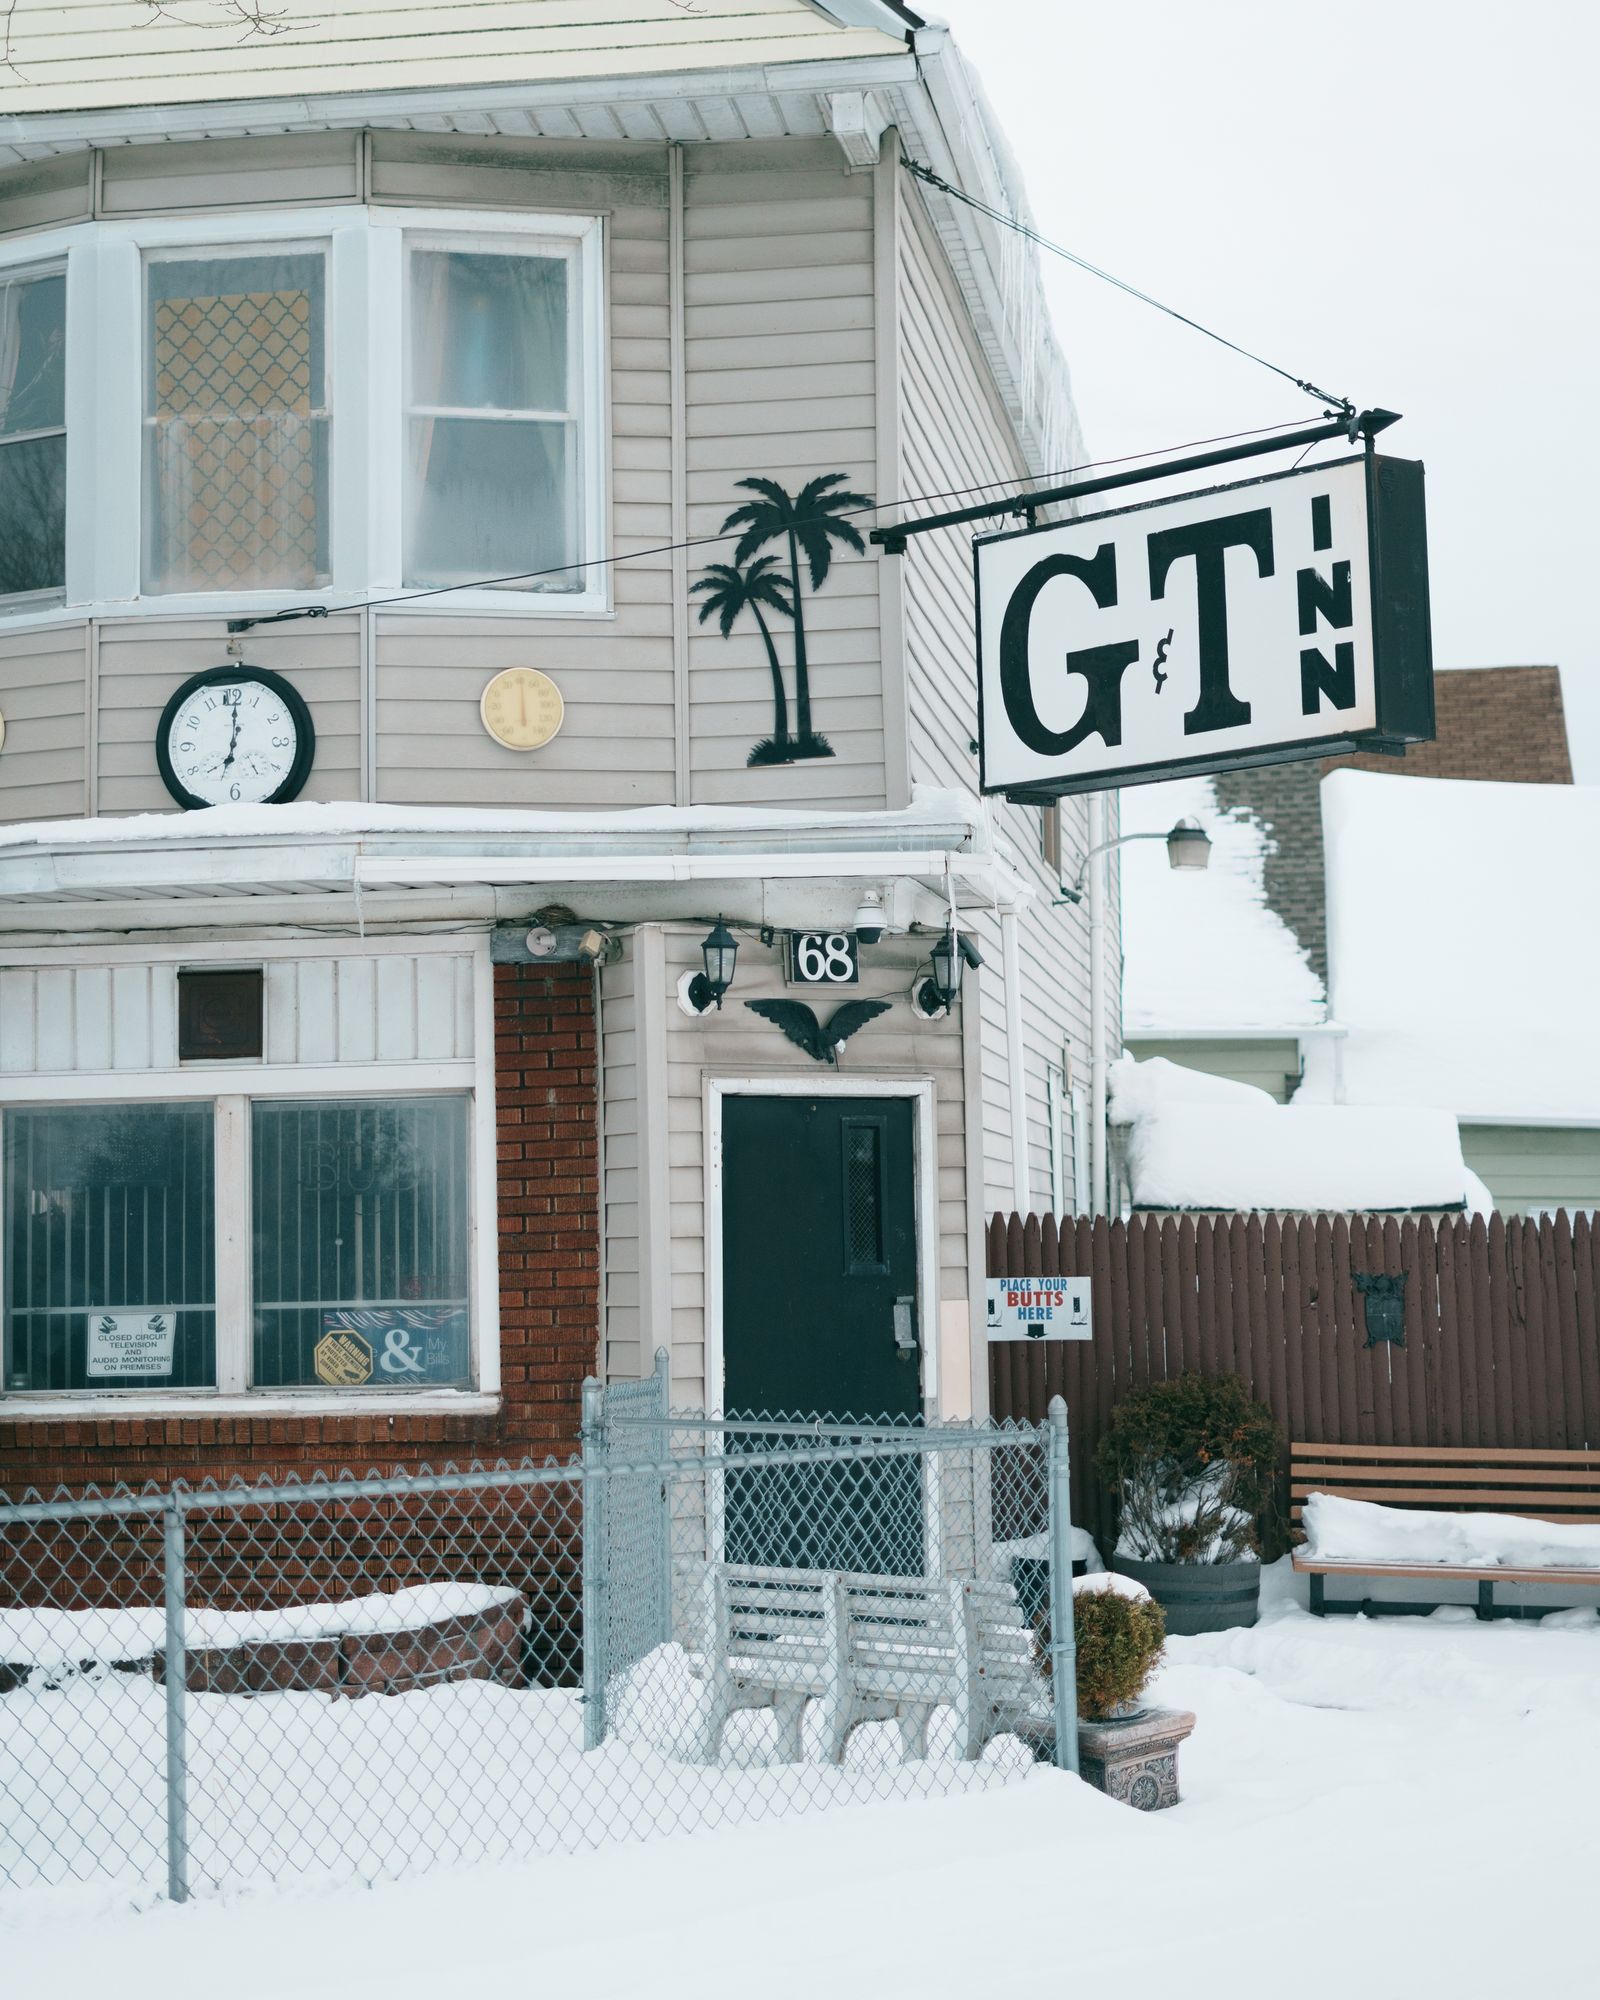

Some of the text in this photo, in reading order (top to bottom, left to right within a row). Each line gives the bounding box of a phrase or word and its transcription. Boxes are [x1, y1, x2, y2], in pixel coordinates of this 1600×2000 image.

[1297, 494, 1356, 716] INN
[223, 688, 242, 706] 12
[204, 697, 218, 712] 11
[186, 715, 200, 731] 10
[267, 713, 280, 725] 2
[180, 742, 196, 752] 9
[272, 737, 289, 748] 3
[187, 766, 199, 776] 8
[270, 763, 281, 773] 4
[230, 782, 240, 800] 6
[798, 934, 854, 982] 68
[1000, 1278, 1067, 1291] PLACE YOUR
[1007, 1291, 1064, 1307] BUTTS
[1018, 1307, 1053, 1320] HERE
[135, 1333, 168, 1341] CIRCUIT
[428, 1337, 446, 1351] My
[110, 1341, 157, 1349] TELEVISION
[339, 1334, 369, 1367] WARNING
[380, 1329, 426, 1373] &
[427, 1351, 449, 1366] Bills
[120, 1363, 161, 1371] PREMISES
